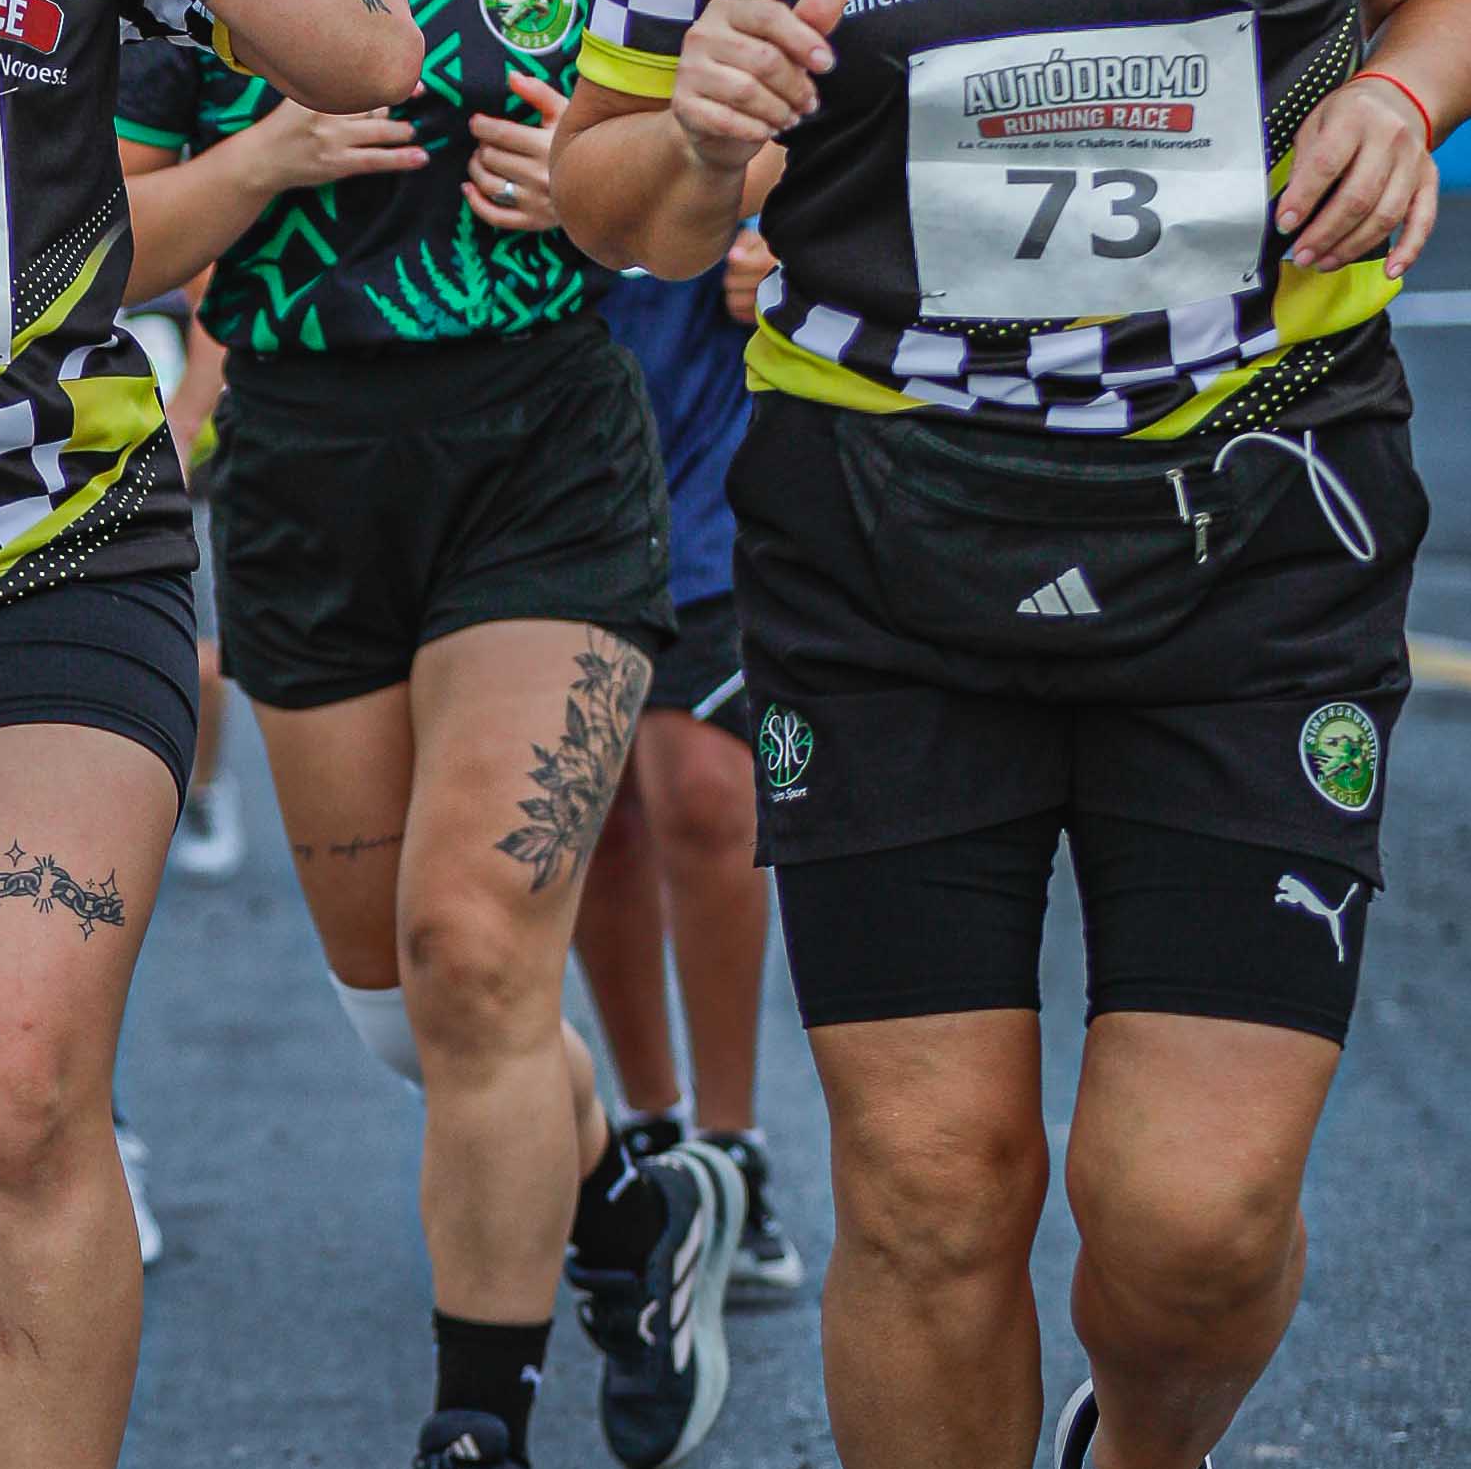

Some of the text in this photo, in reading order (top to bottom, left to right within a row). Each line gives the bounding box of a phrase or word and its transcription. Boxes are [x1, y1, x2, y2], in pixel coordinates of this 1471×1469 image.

[963, 47, 1210, 117] AUTÓDROMO
[1003, 106, 1172, 135] RUNNING RACE
[1005, 167, 1164, 261] 73
